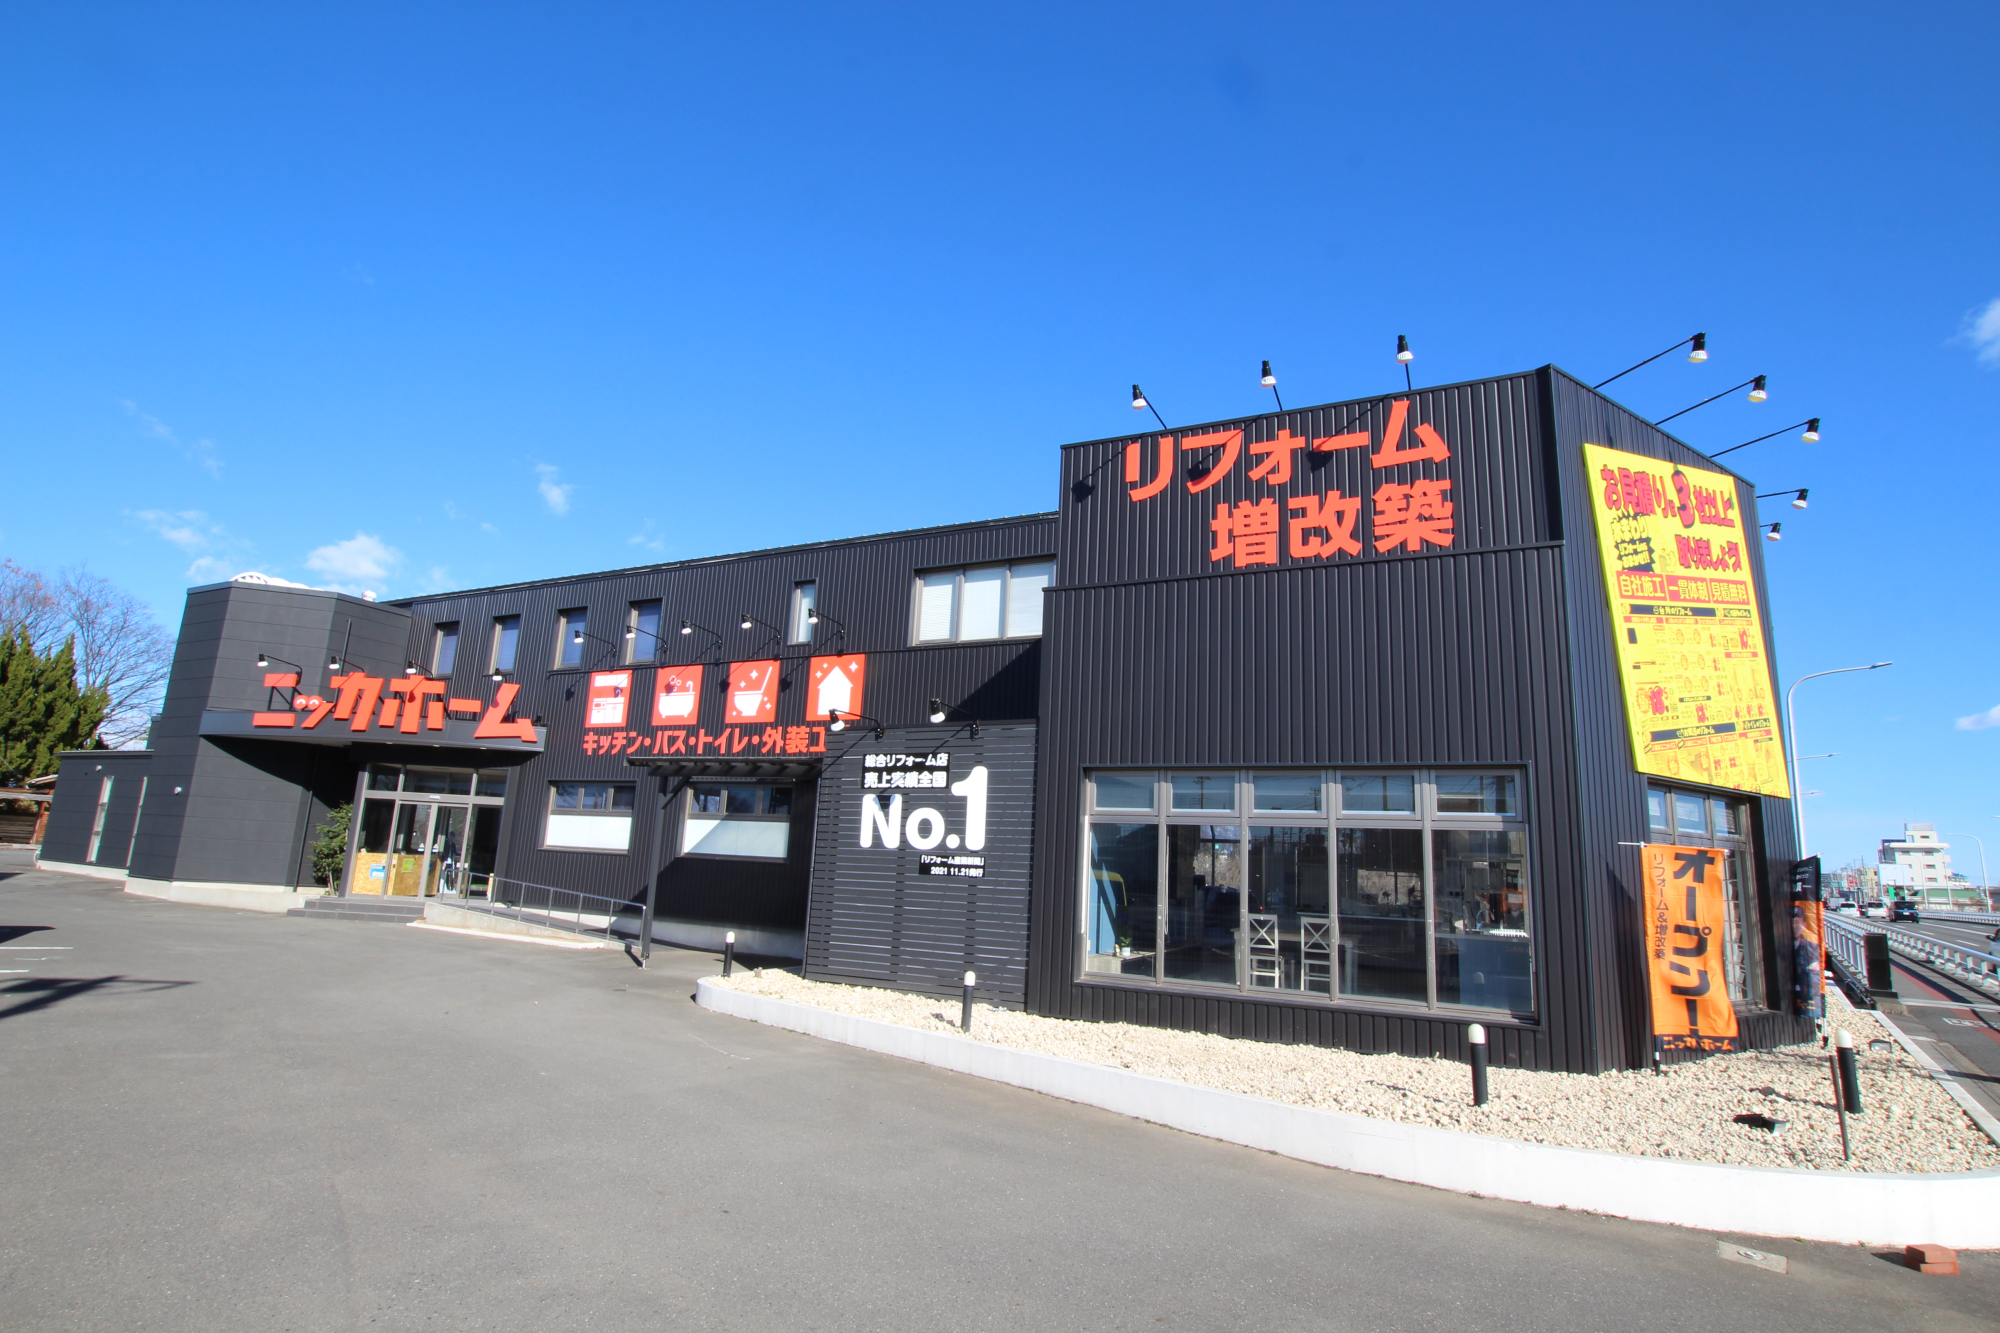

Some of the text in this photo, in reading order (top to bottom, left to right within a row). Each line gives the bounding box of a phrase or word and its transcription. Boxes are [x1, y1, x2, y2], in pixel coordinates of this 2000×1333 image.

[1125, 400, 1451, 502] リフォーム
[1209, 479, 1455, 568] 増改築
[1619, 574, 1748, 603] 自社施工 一貫体制 見積無料
[252, 672, 538, 742] ニッカホーム
[863, 770, 947, 789] 売上実績全国
[864, 753, 949, 768] 総合リフォーム店
[859, 765, 988, 851] No.1
